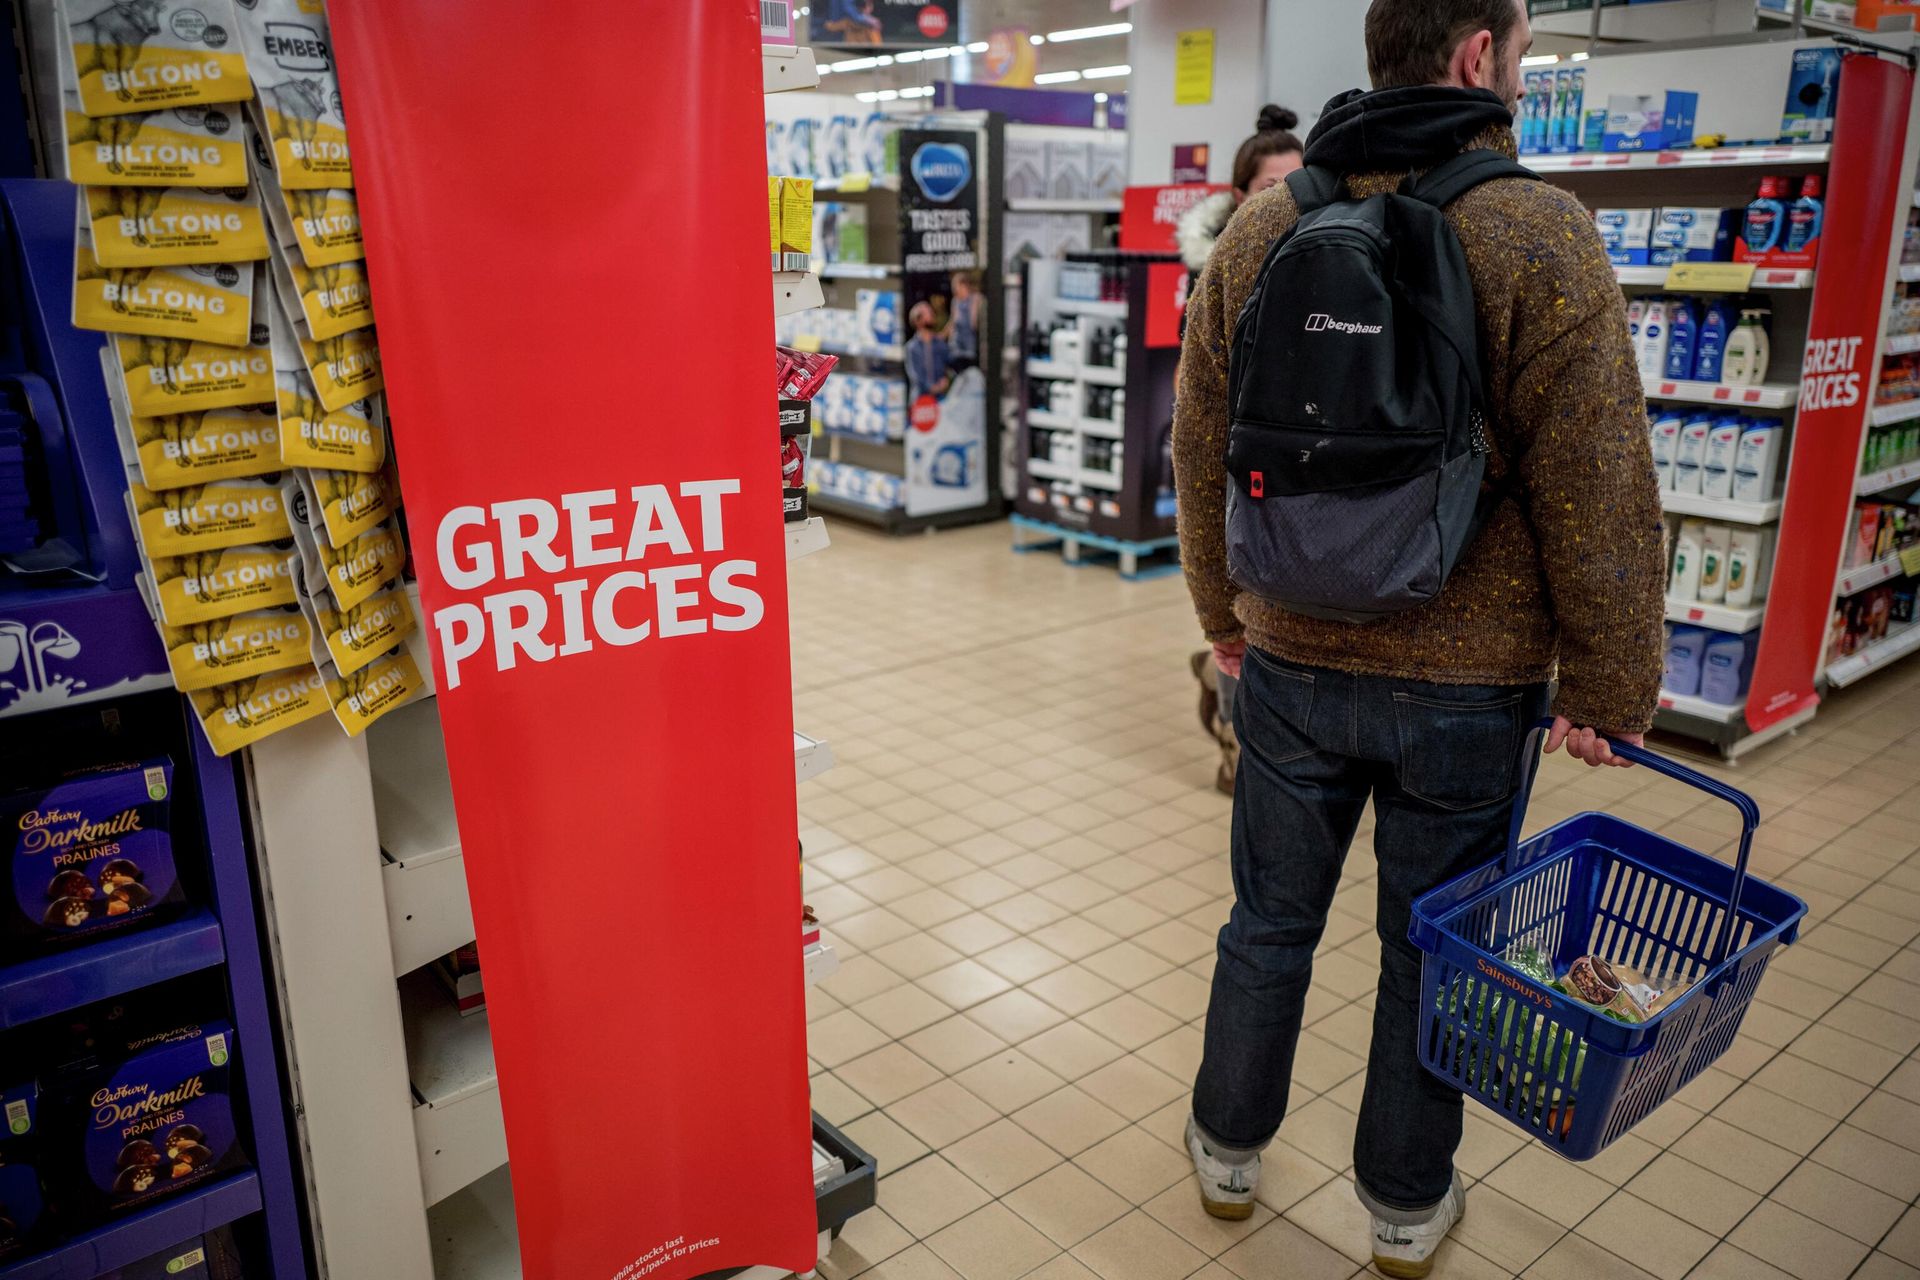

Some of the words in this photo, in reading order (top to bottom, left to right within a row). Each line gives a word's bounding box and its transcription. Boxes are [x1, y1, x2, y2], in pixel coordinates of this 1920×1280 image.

[264, 36, 330, 60] EMBER
[102, 60, 222, 92] BILTONG
[96, 144, 221, 165] BILTONG
[119, 213, 242, 237] BILTONG
[103, 283, 225, 315] BILTONG
[1327, 319, 1383, 334] berghaus
[149, 357, 268, 385] BILTONG
[1802, 336, 1863, 375] GREAT
[163, 427, 276, 459] BILTONG
[301, 421, 372, 445] BILTONG
[163, 496, 278, 528] BILTONG
[436, 478, 741, 591] GREAT
[338, 539, 395, 582] BILTONG
[183, 560, 290, 596] BILTONG
[340, 601, 400, 646] BILTONG
[433, 559, 765, 691] PRICES
[193, 624, 299, 662] BILTONG
[223, 675, 323, 725] BILTONG
[18, 808, 82, 831] Cadbury
[22, 808, 144, 854] Darkmilk
[53, 843, 121, 868] PRALINES
[1477, 958, 1553, 1009] Sainsbury's
[91, 1083, 149, 1108] Cadbury
[94, 1075, 206, 1130] Darkmilk
[122, 1109, 185, 1139] PRALINES
[634, 1246, 664, 1267] stocks
[664, 1236, 684, 1250] last
[672, 1247, 687, 1259] for
[688, 1236, 720, 1254] prices
